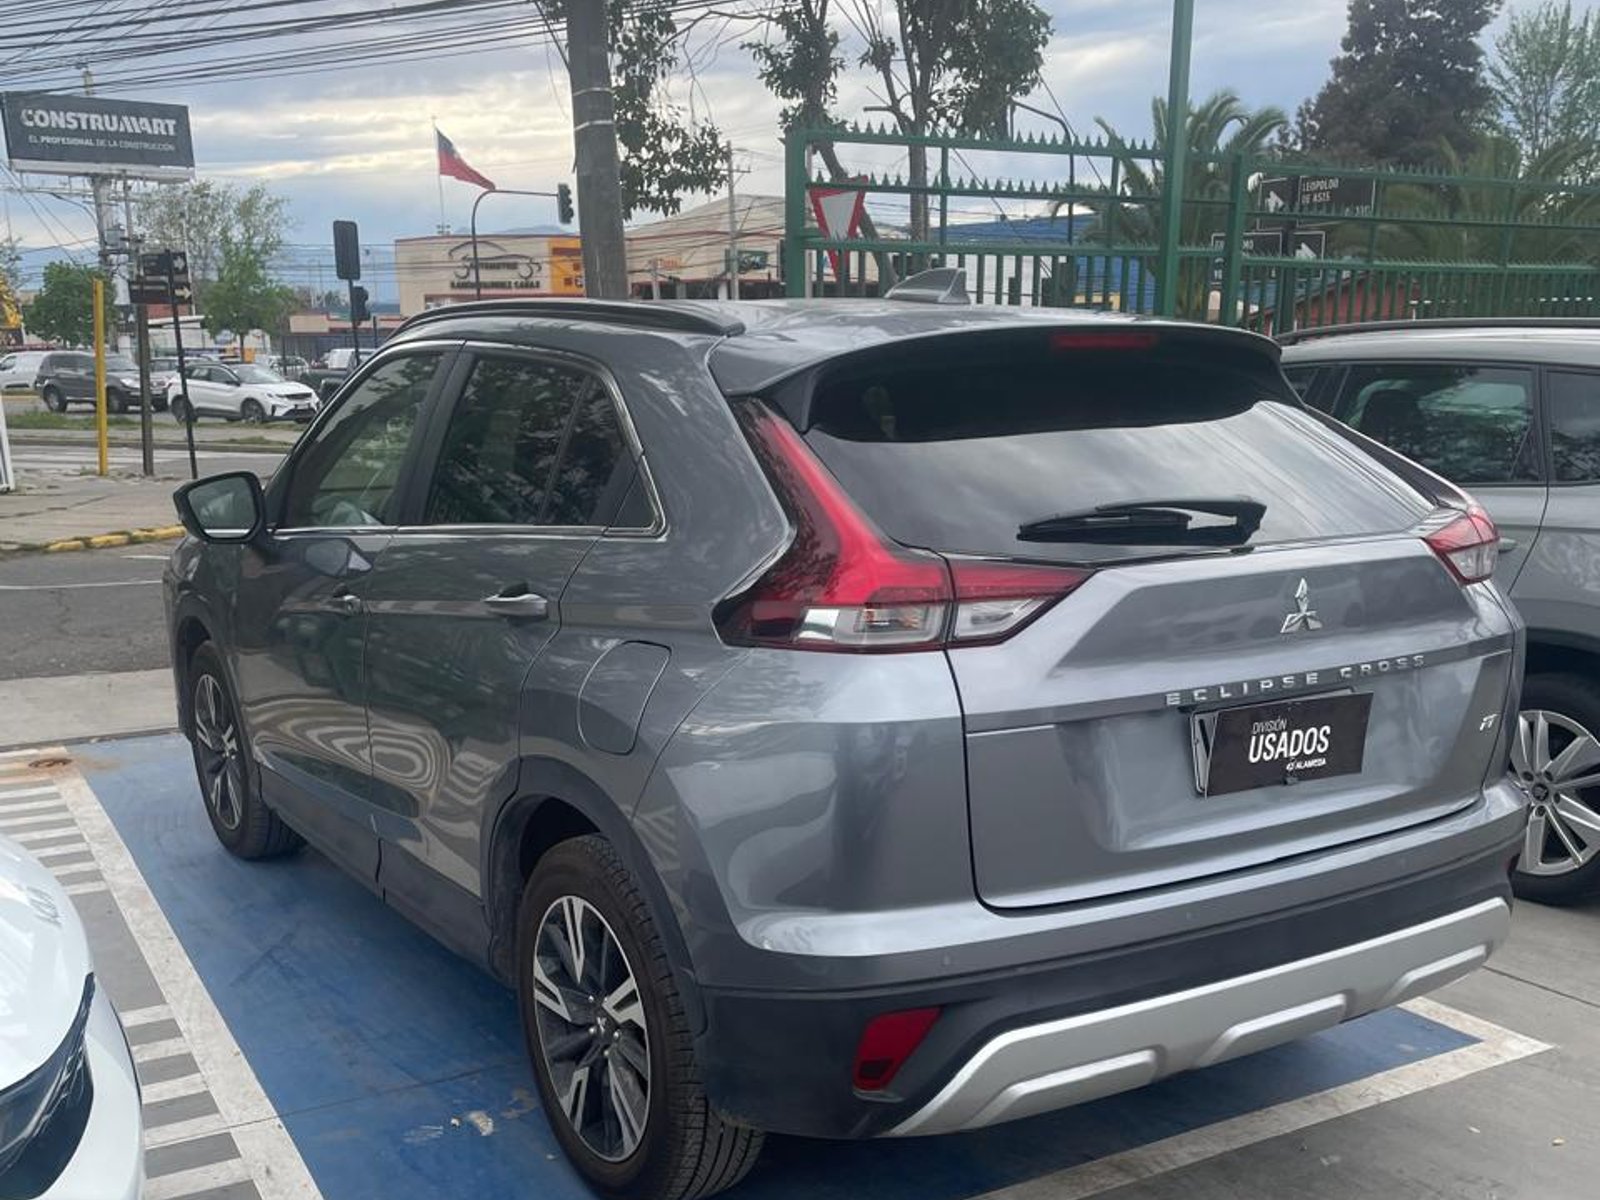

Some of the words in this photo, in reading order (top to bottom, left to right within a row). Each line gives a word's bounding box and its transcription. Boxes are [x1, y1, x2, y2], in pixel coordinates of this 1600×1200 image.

[21, 109, 177, 136] CONSTRUMART
[40, 136, 94, 146] PROFESIONAL
[96, 138, 107, 147] DE
[108, 139, 119, 148] LA
[1166, 672, 1319, 705] ECLIPSE
[1340, 655, 1424, 679] CROSS
[1249, 725, 1331, 763] USADOS
